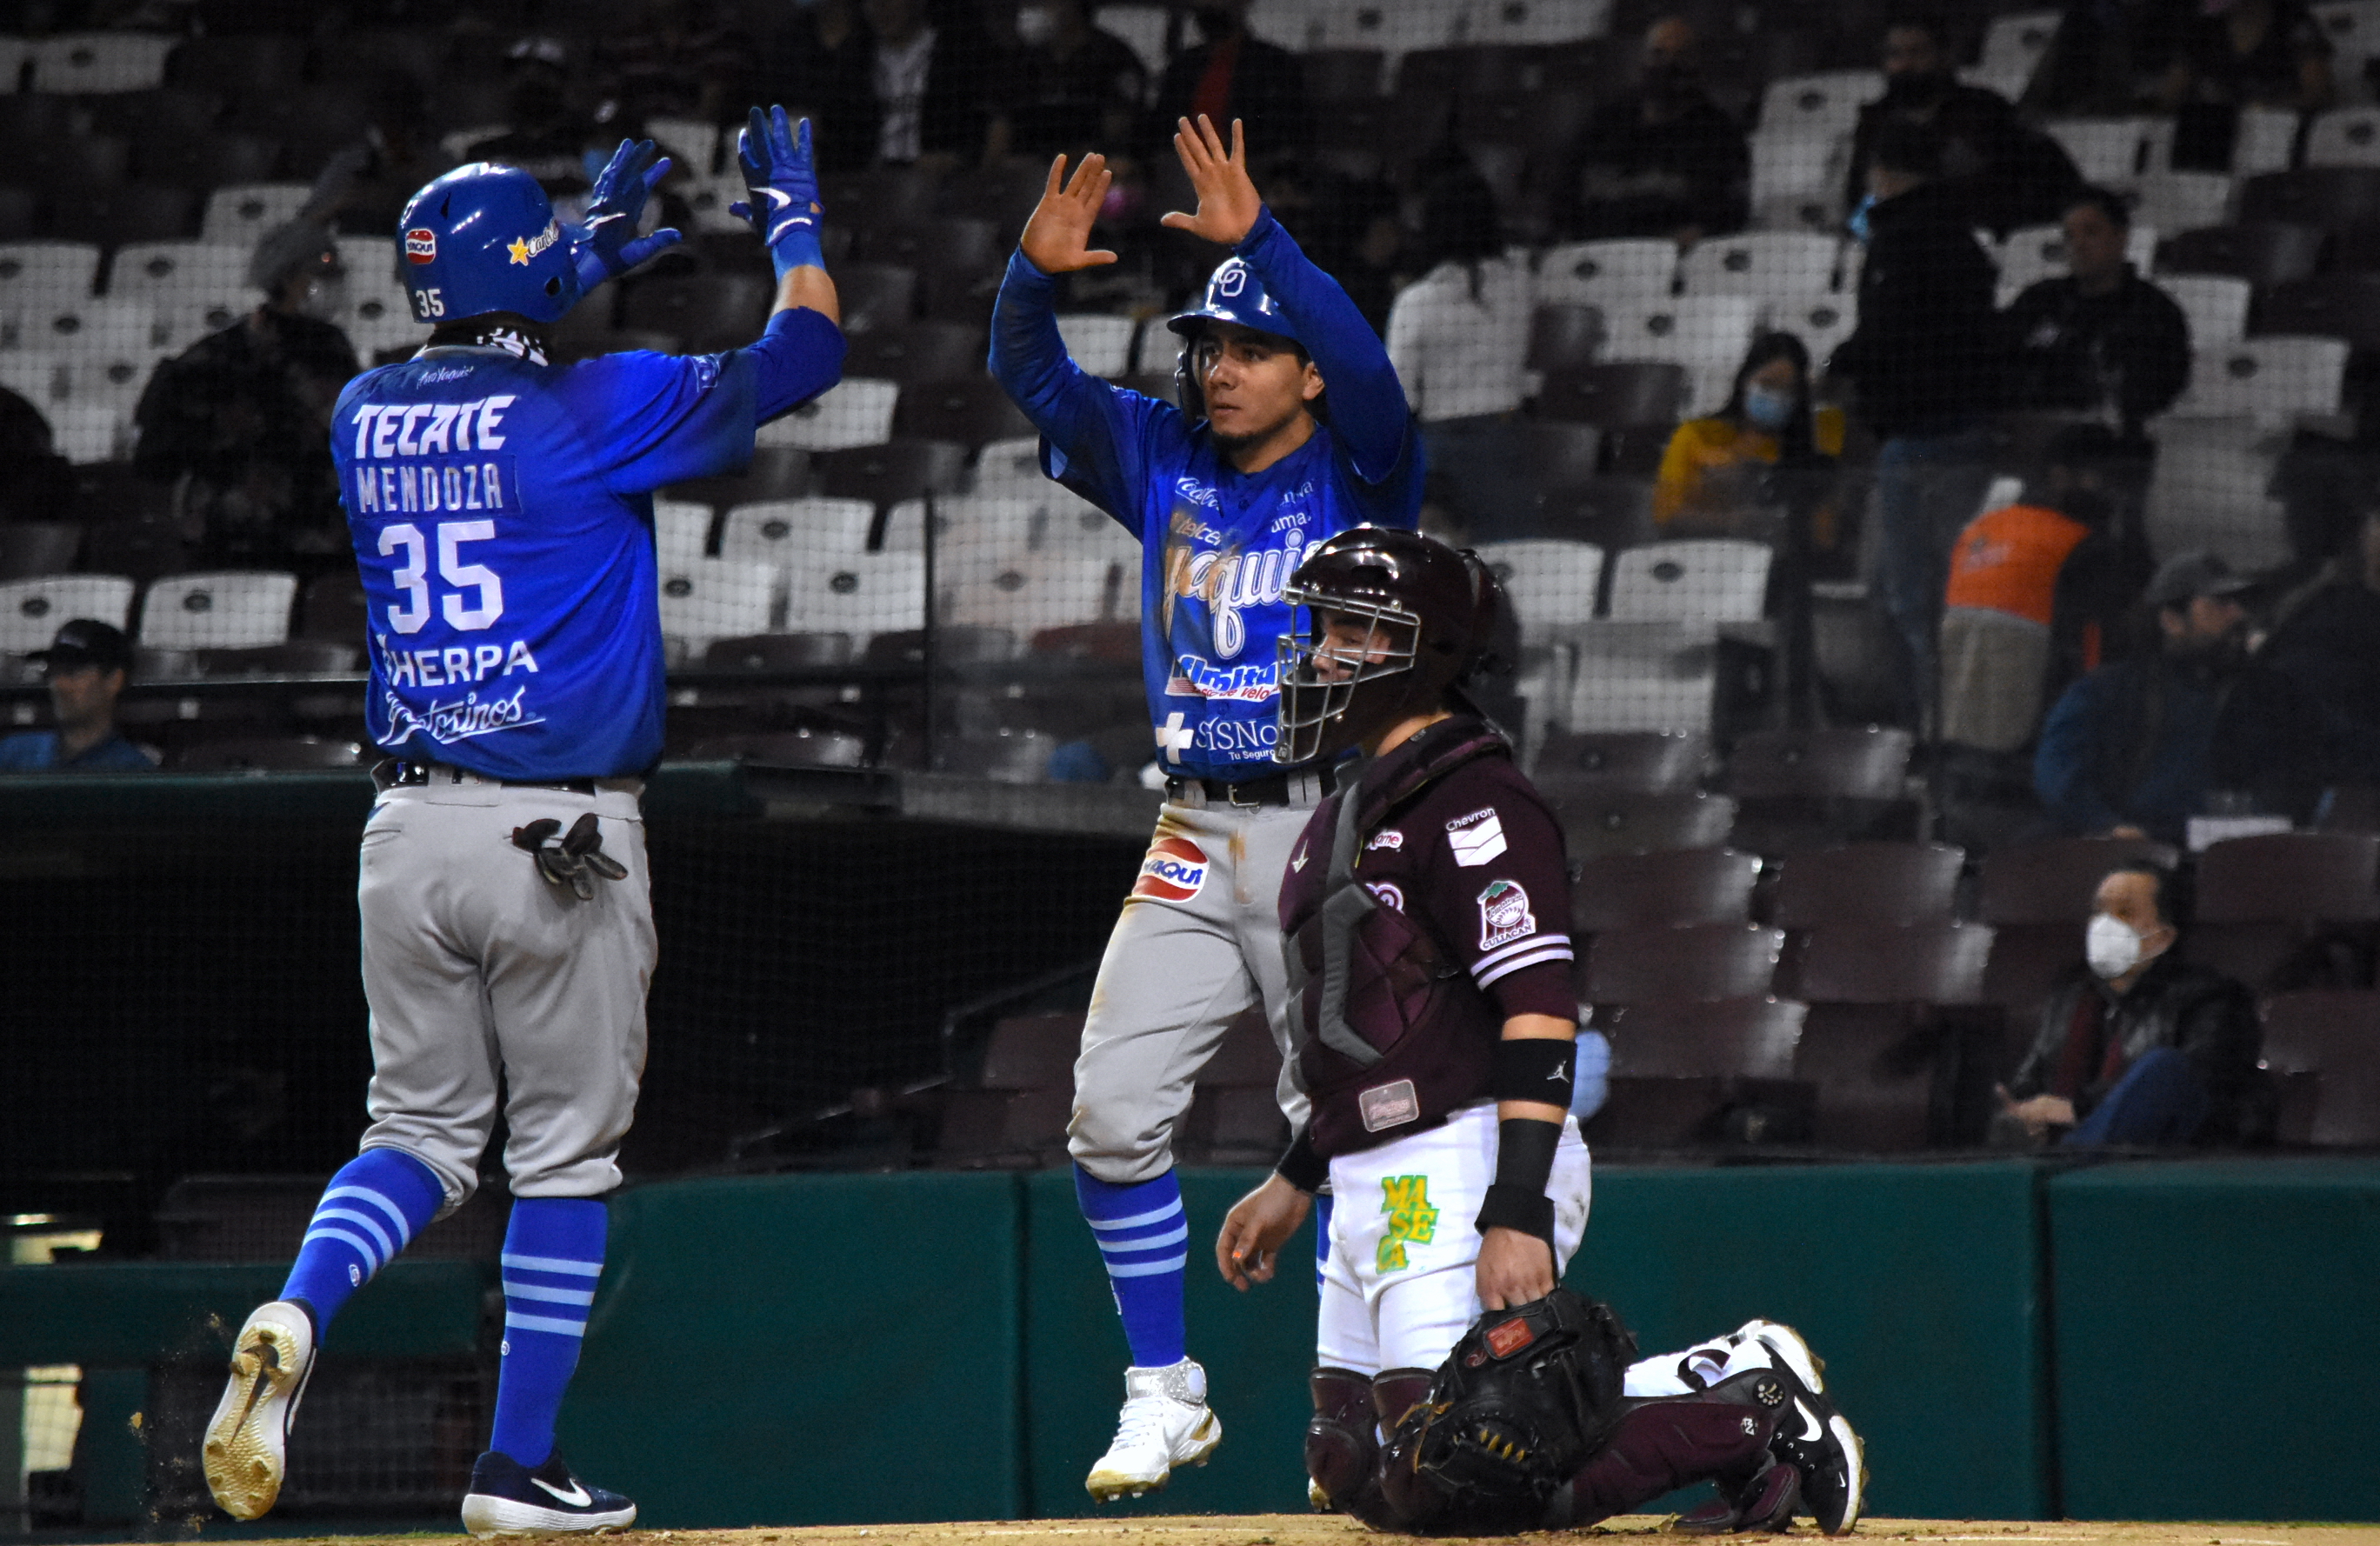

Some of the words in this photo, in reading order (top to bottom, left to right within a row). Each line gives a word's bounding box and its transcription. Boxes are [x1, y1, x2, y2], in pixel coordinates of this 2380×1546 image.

[407, 241, 434, 253] YAQUI
[416, 288, 445, 317] 35
[351, 395, 517, 459] TECATE
[356, 463, 503, 513] MENDOZA
[377, 520, 503, 634] 35
[1163, 528, 1323, 660] Yaqui
[1229, 751, 1241, 761] Tu
[1243, 749, 1276, 761] Seguro
[1445, 807, 1496, 831] Chevron
[1482, 923, 1532, 950] CULIACAN
